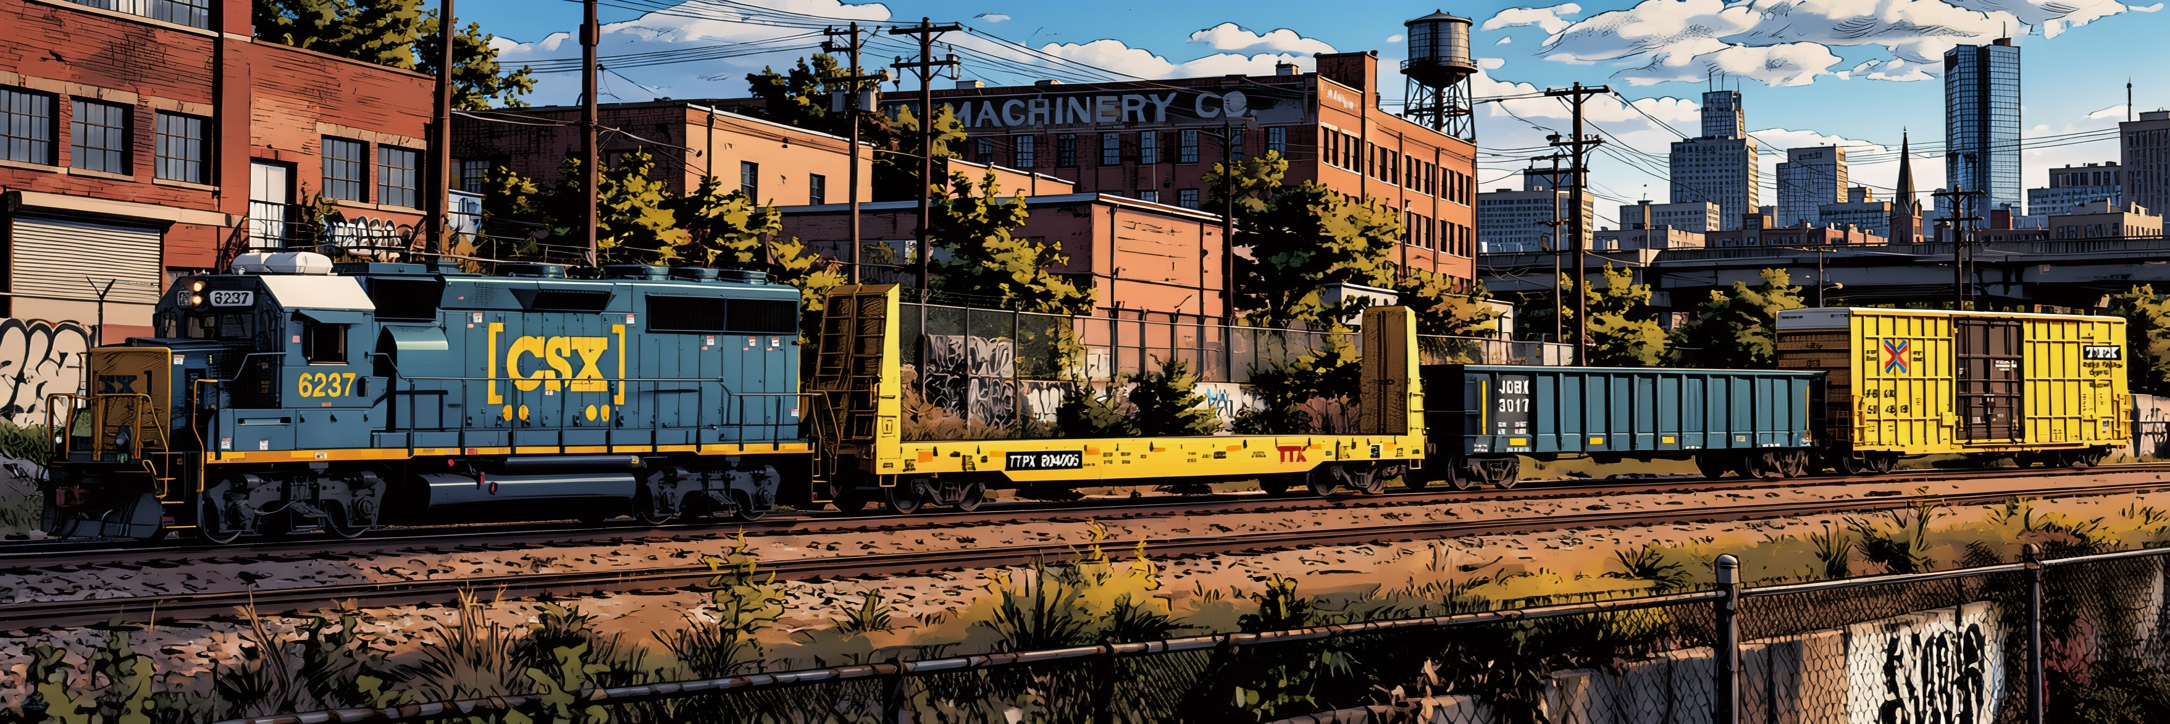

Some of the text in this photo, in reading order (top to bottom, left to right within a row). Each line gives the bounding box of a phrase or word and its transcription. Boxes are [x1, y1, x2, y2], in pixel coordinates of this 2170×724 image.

[948, 92, 1177, 128] MACHINERY
[214, 292, 250, 305] 6237
[298, 372, 356, 398] 6237
[1010, 455, 1036, 467] TTPX
